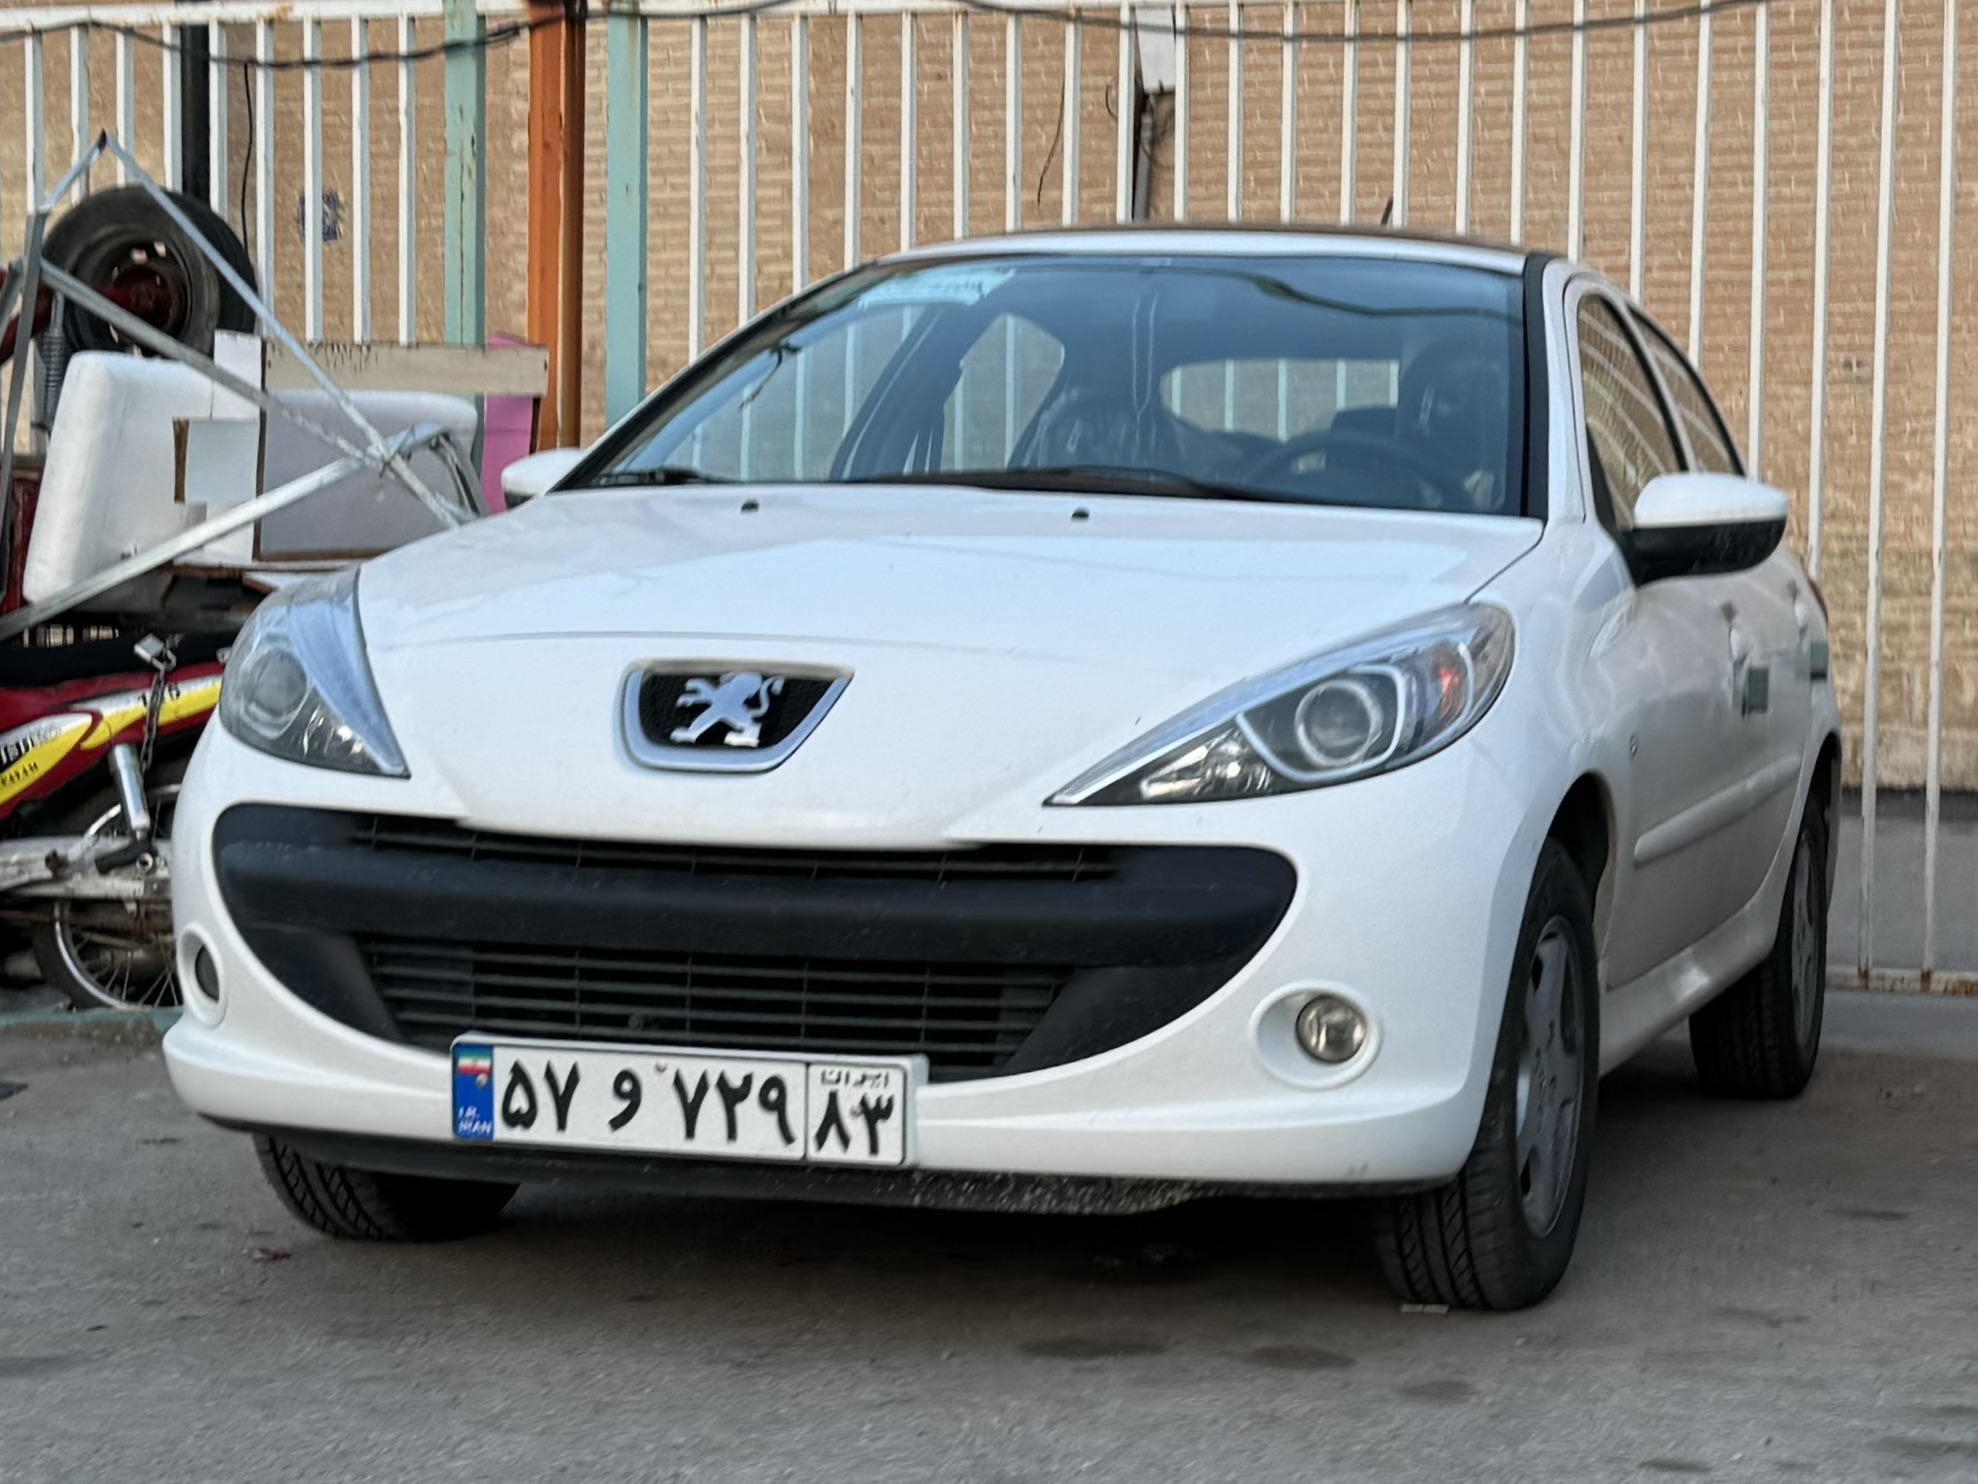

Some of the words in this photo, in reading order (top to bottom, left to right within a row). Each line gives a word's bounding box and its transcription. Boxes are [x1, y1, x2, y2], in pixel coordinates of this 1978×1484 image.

[820, 1069, 890, 1088] ایران
[502, 1058, 581, 1132] ۵۷
[607, 1067, 642, 1132] و
[673, 1068, 796, 1146] ۷۲۹
[813, 1088, 895, 1157] ۸۳
[457, 1121, 493, 1135] IRAN
